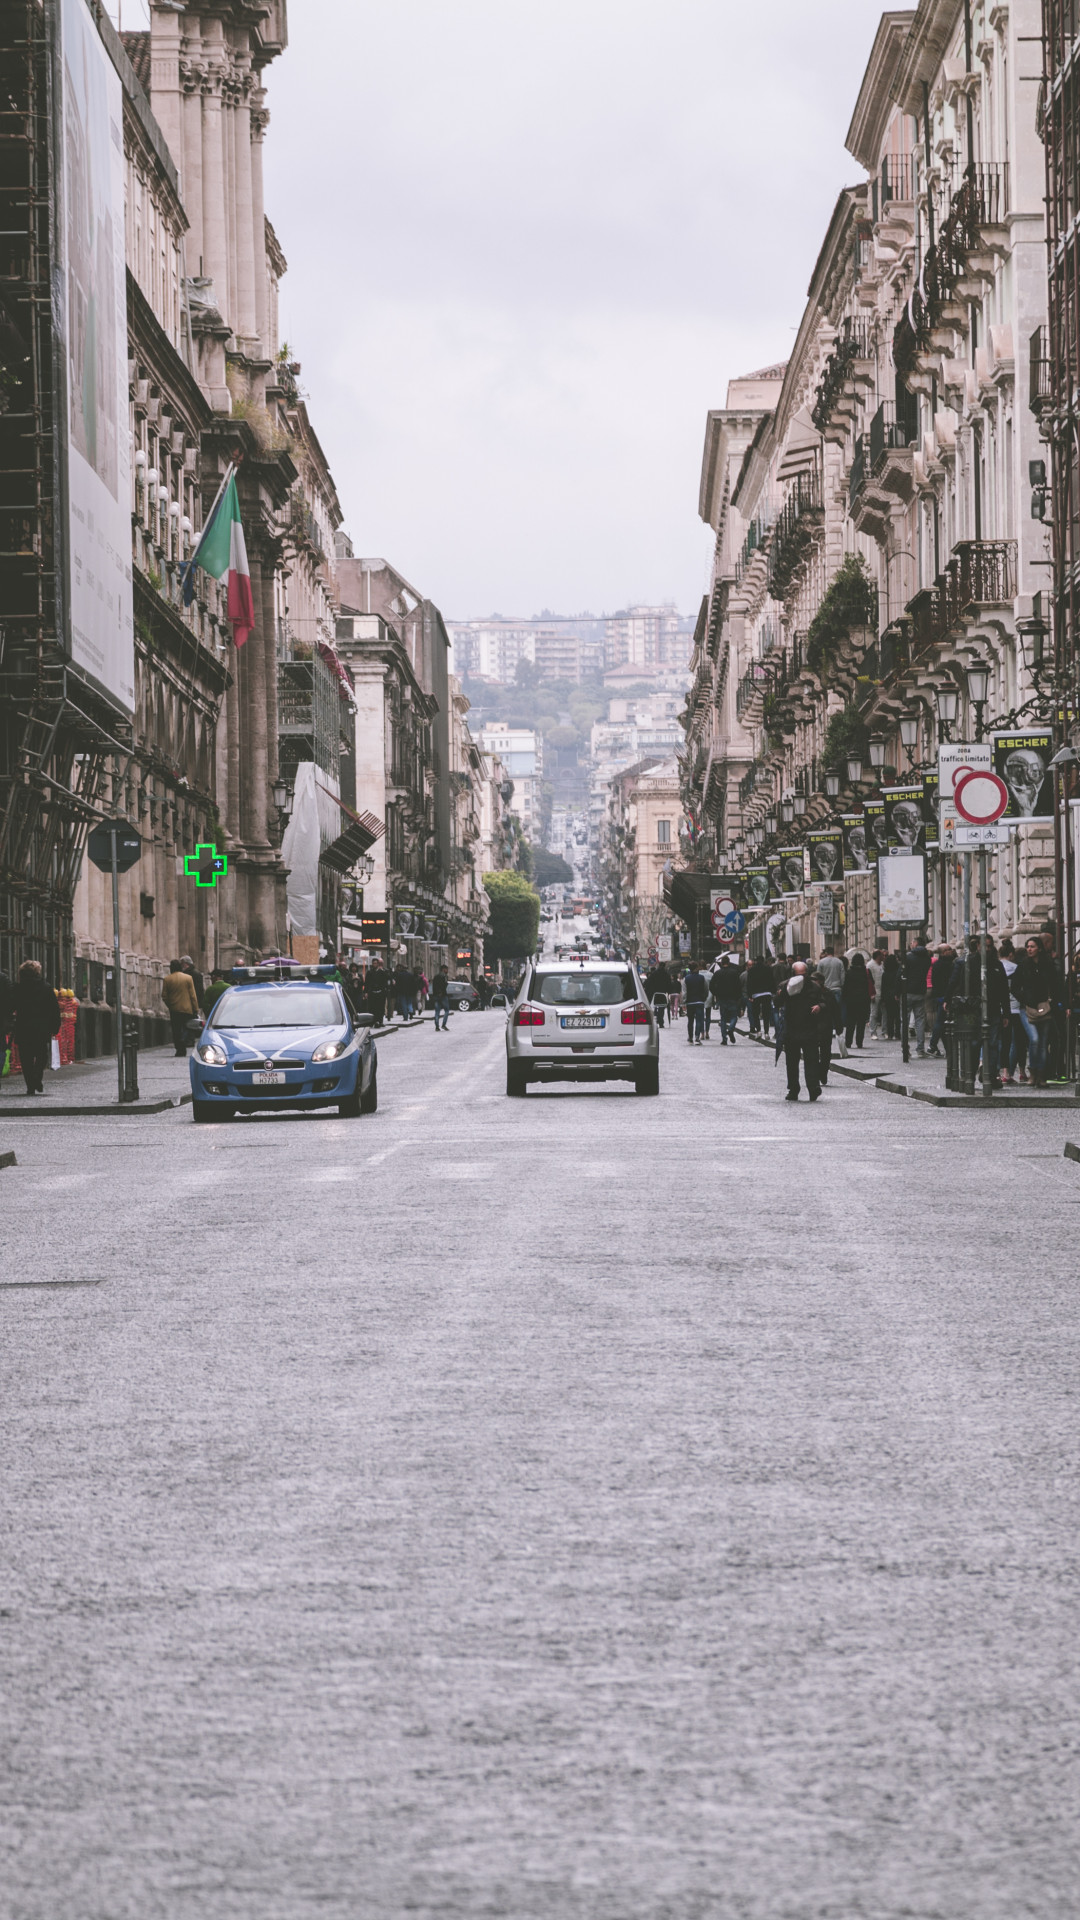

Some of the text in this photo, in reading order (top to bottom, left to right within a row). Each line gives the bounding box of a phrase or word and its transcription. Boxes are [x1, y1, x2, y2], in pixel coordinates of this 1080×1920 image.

[998, 738, 1048, 748] ESCHER
[886, 792, 924, 801] ESCHER
[721, 929, 733, 939] 20
